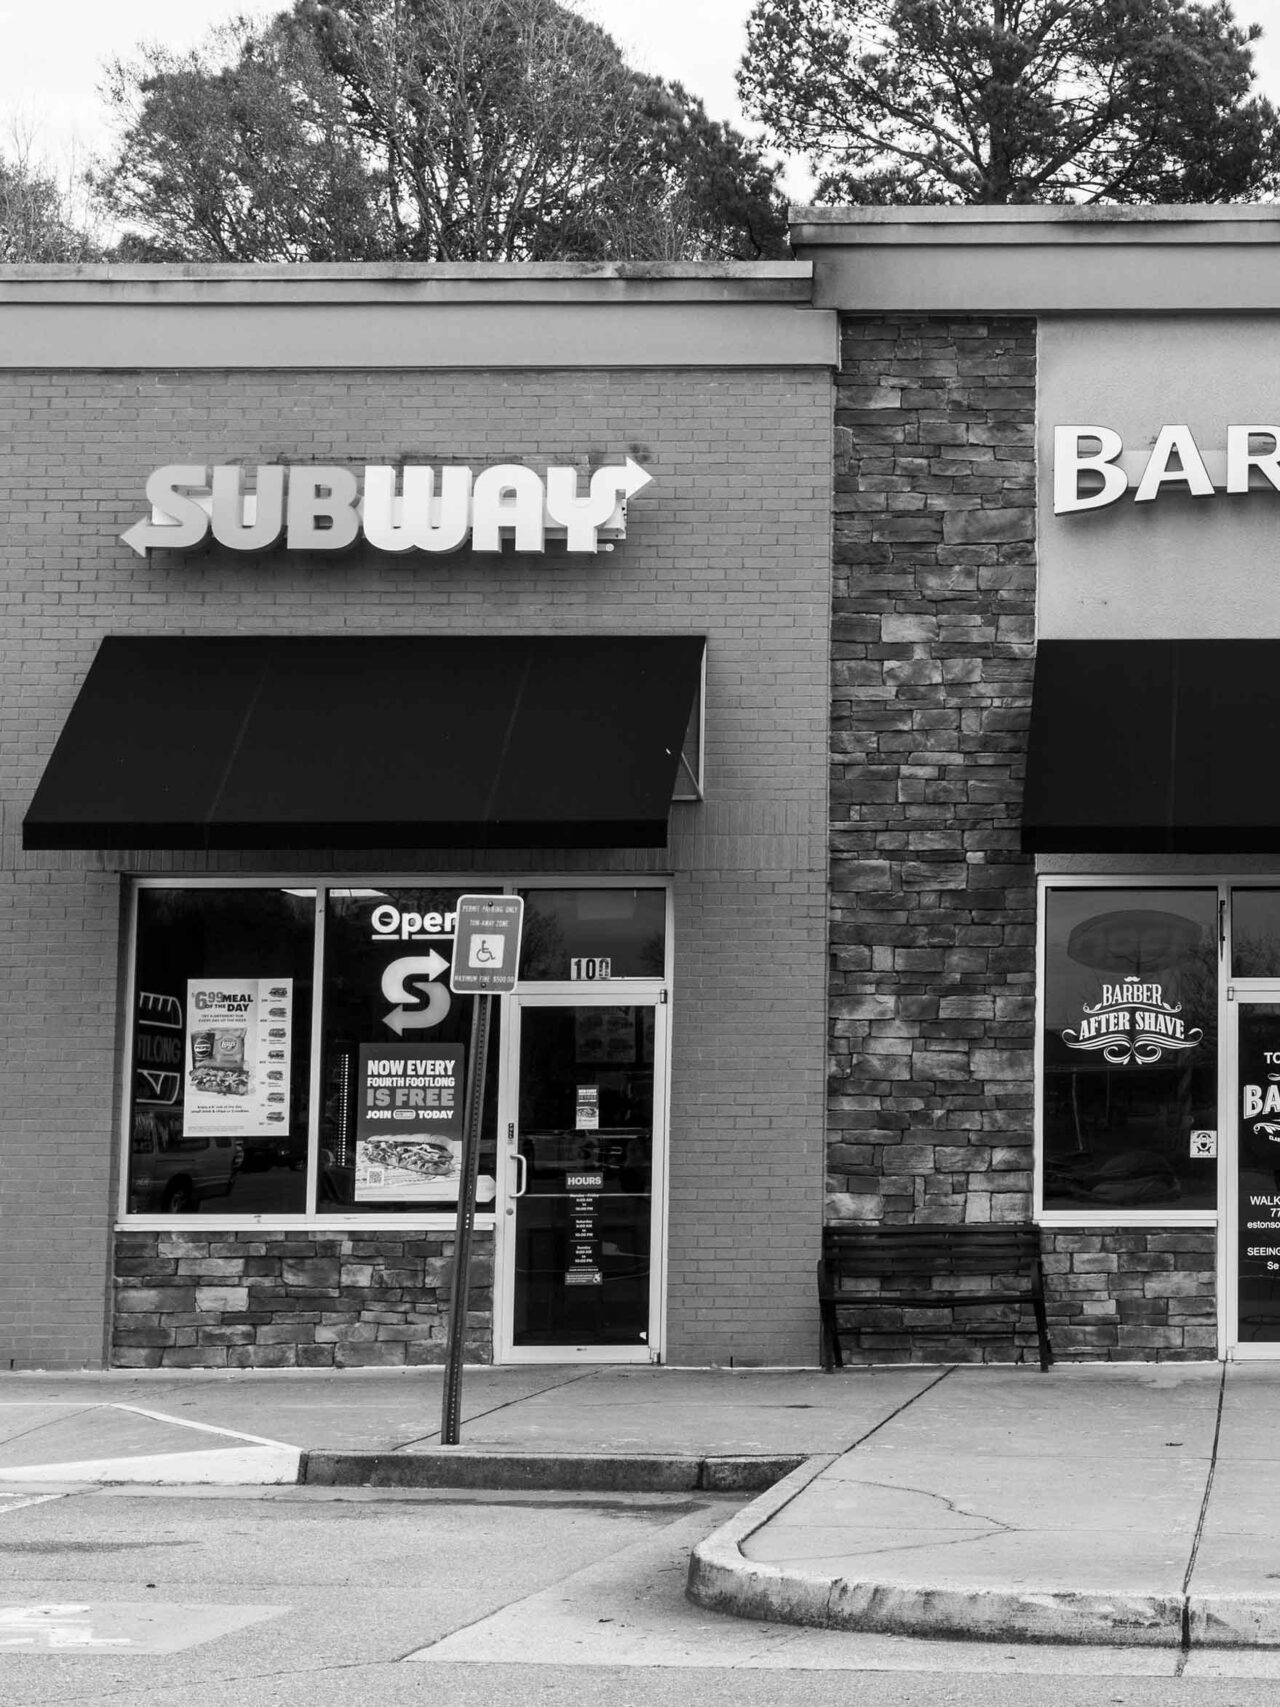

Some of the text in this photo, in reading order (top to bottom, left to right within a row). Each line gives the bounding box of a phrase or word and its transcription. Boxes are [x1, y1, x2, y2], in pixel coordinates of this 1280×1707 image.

[119, 456, 654, 557] SUBWAY
[574, 958, 610, 980] 100
[222, 994, 254, 1002] MEAL
[1102, 984, 1163, 1007] BARBER
[227, 1003, 250, 1012] DAY
[1079, 1011, 1185, 1041] AFTER SHAVE
[367, 1060, 456, 1076] NOW EVERY
[367, 1077, 456, 1087] FOURTH FOOTLONG
[366, 1088, 455, 1107] IS FREE
[366, 1110, 392, 1120] JOIN
[418, 1110, 454, 1119] TODAY
[567, 1176, 602, 1186] HOURS
[1267, 1261, 1279, 1270] Se
